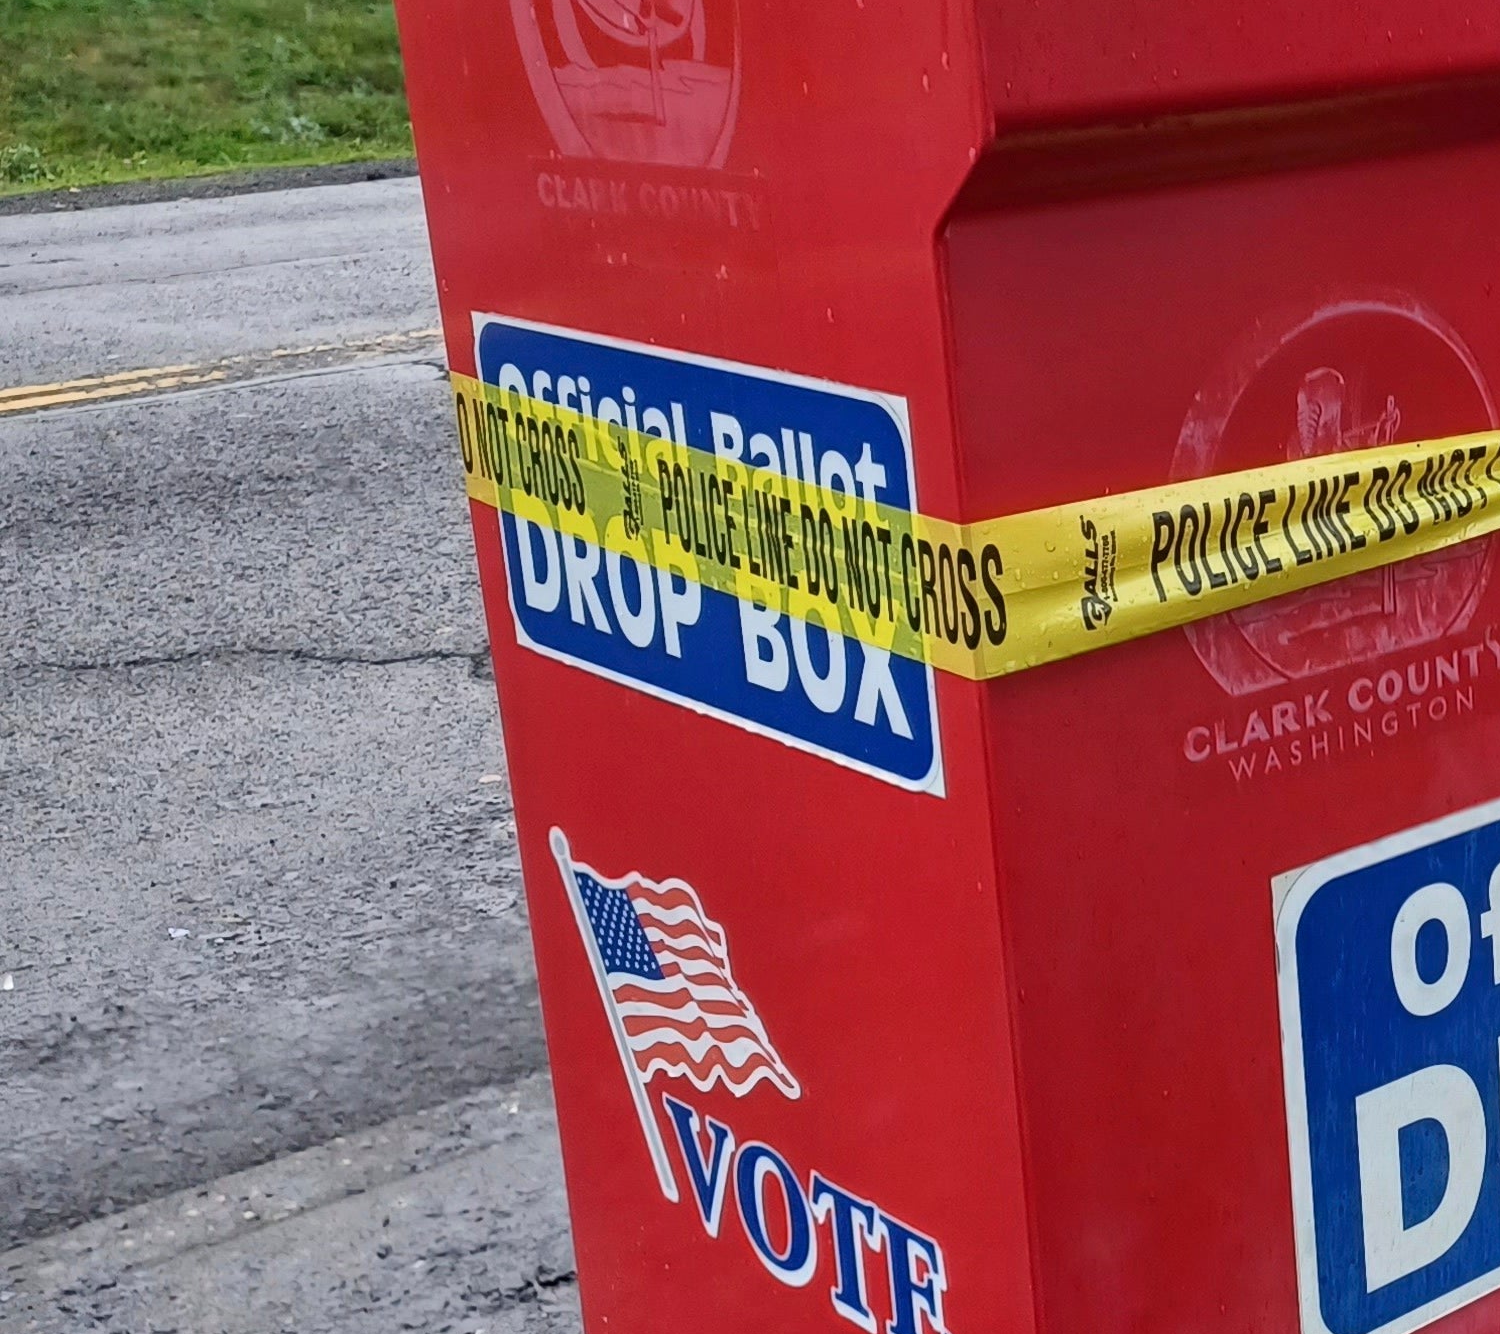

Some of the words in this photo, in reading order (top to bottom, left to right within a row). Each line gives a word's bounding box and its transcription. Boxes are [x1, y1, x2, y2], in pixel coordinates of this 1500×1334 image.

[473, 398, 514, 489] NOT
[515, 411, 586, 516] CROSS
[498, 362, 689, 483] Official
[710, 411, 890, 529] Ballot
[657, 458, 741, 570] POLICE
[741, 485, 799, 591] LINE
[800, 503, 838, 605] DO
[842, 516, 895, 624] NOT
[901, 532, 1008, 651] CROSS
[1080, 515, 1113, 632] GALLS
[1151, 487, 1283, 603] POLICE
[1281, 471, 1367, 566] LINE
[1366, 459, 1421, 543] DO
[1417, 445, 1489, 526] NOT
[509, 487, 701, 658] DROP
[735, 556, 915, 741] BOX
[1182, 684, 1334, 767] CLARK
[1228, 685, 1478, 785] WASHINGTON
